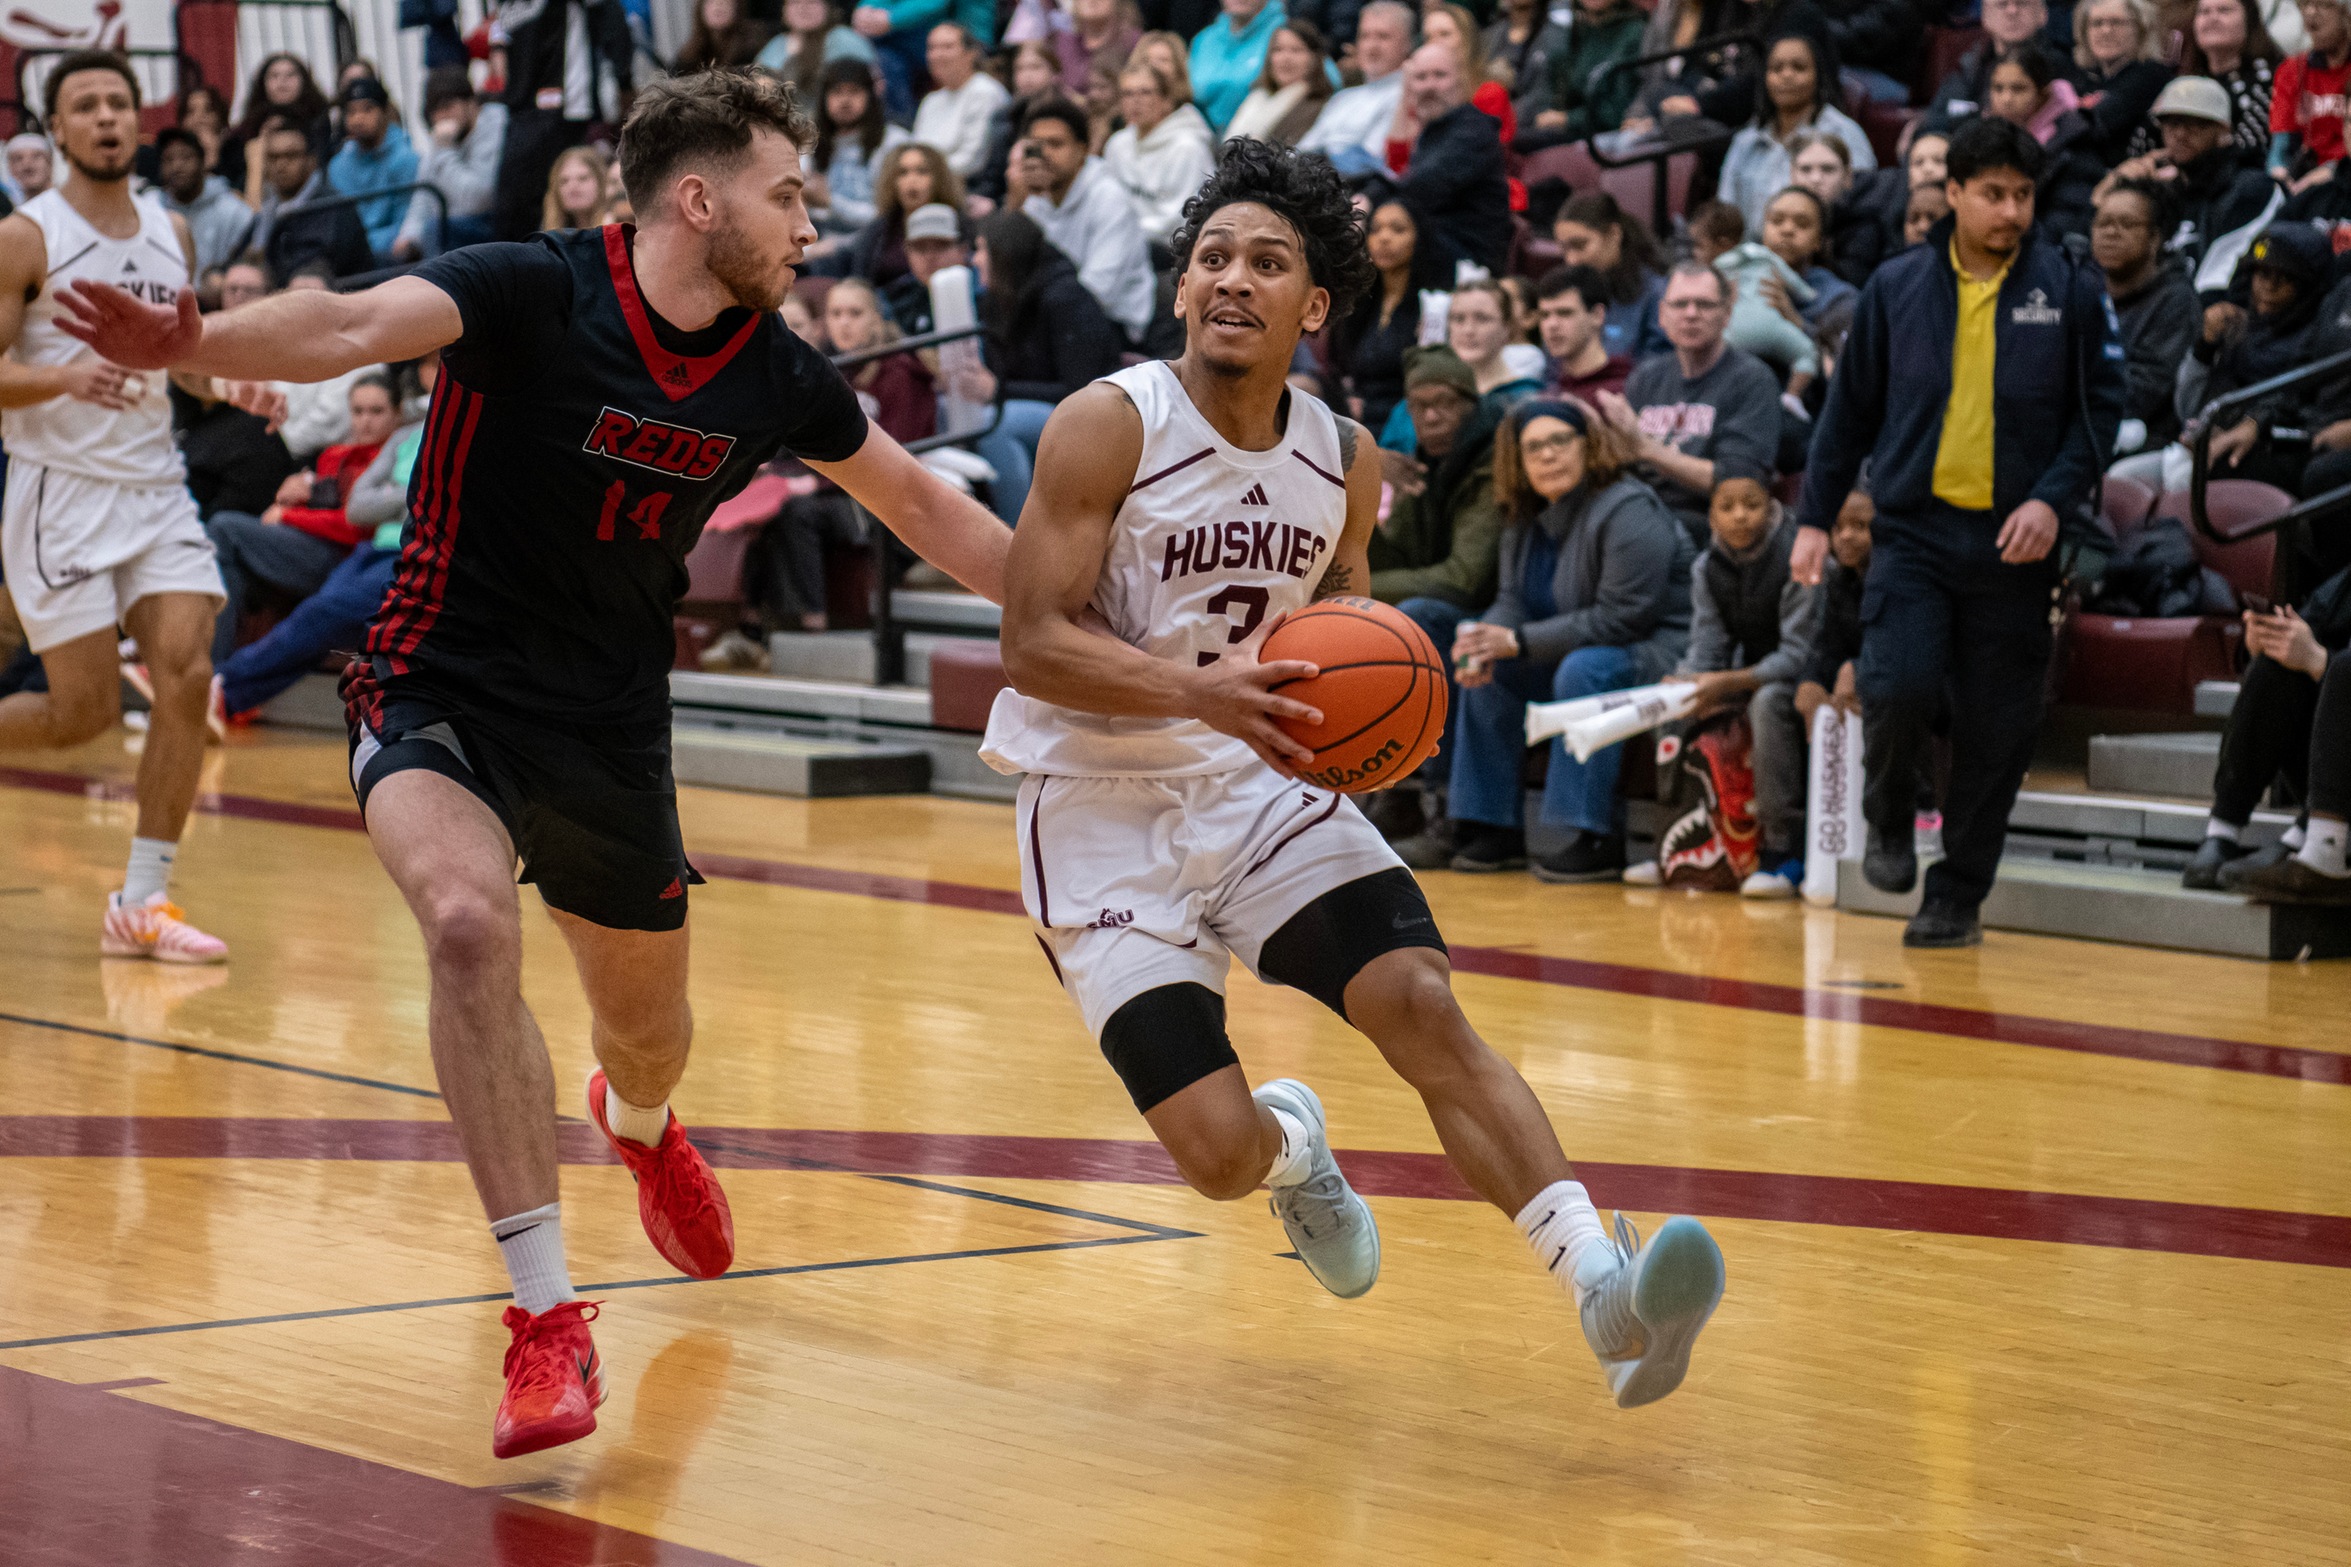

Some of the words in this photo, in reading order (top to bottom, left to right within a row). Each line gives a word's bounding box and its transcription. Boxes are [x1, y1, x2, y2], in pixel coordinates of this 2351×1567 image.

[661, 373, 692, 388] adidas
[583, 406, 737, 481] REDS
[596, 480, 673, 541] 14
[1161, 521, 1326, 583] HUSKIES
[1197, 585, 1269, 667] 3
